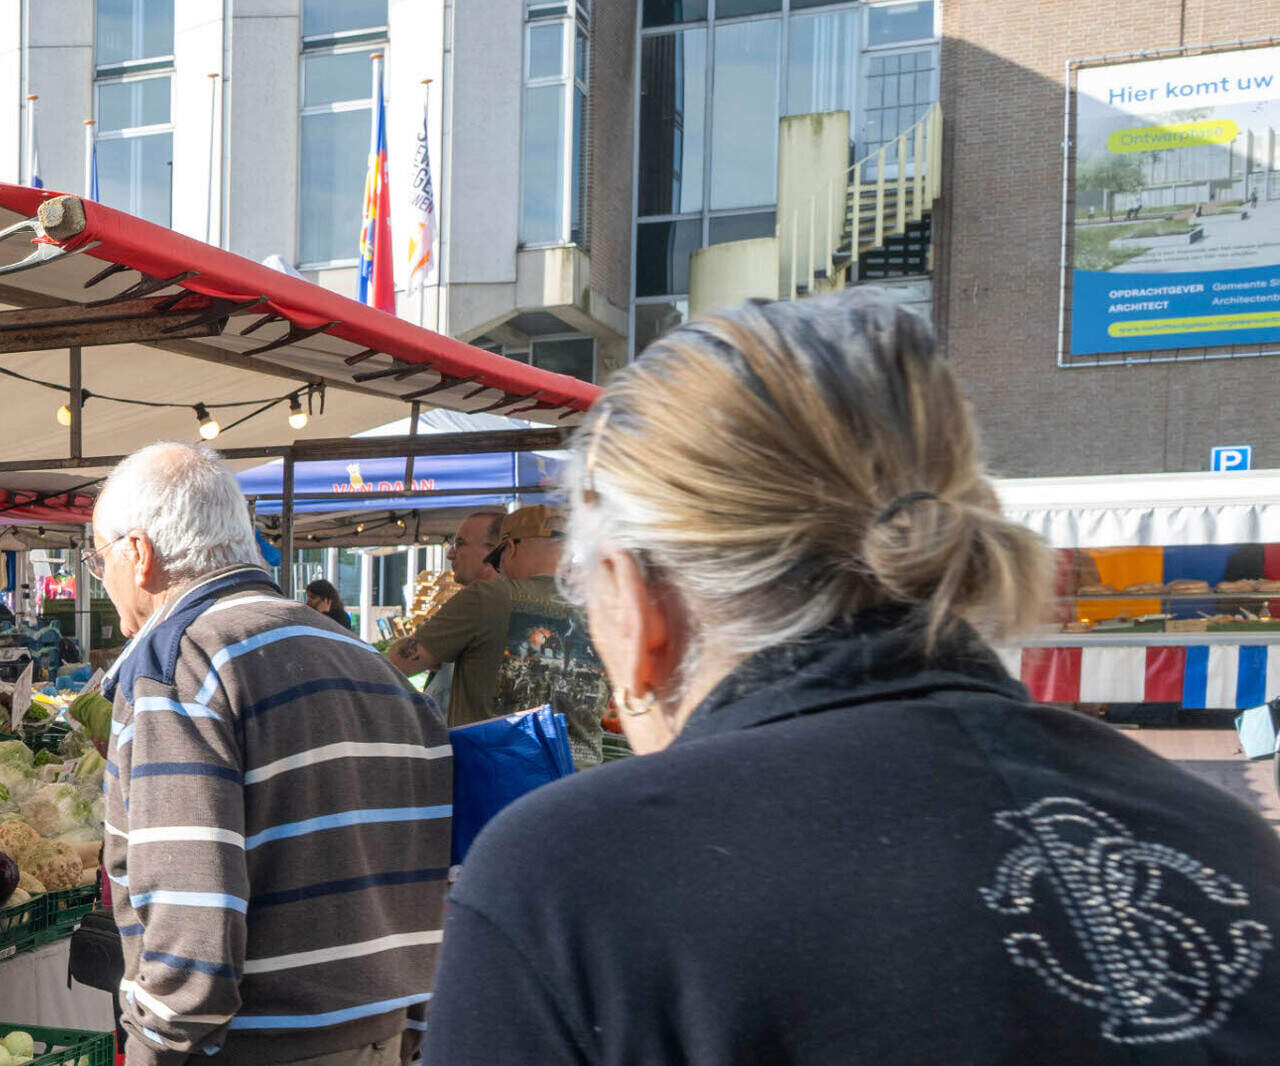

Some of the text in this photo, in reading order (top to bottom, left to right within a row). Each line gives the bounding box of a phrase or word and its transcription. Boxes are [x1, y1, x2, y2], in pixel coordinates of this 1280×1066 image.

[1108, 74, 1274, 104] Hier komt uw
[1108, 283, 1204, 299] OPDRACHTGEVER
[1108, 301, 1170, 313] ARCHITECT
[1220, 451, 1242, 471] P
